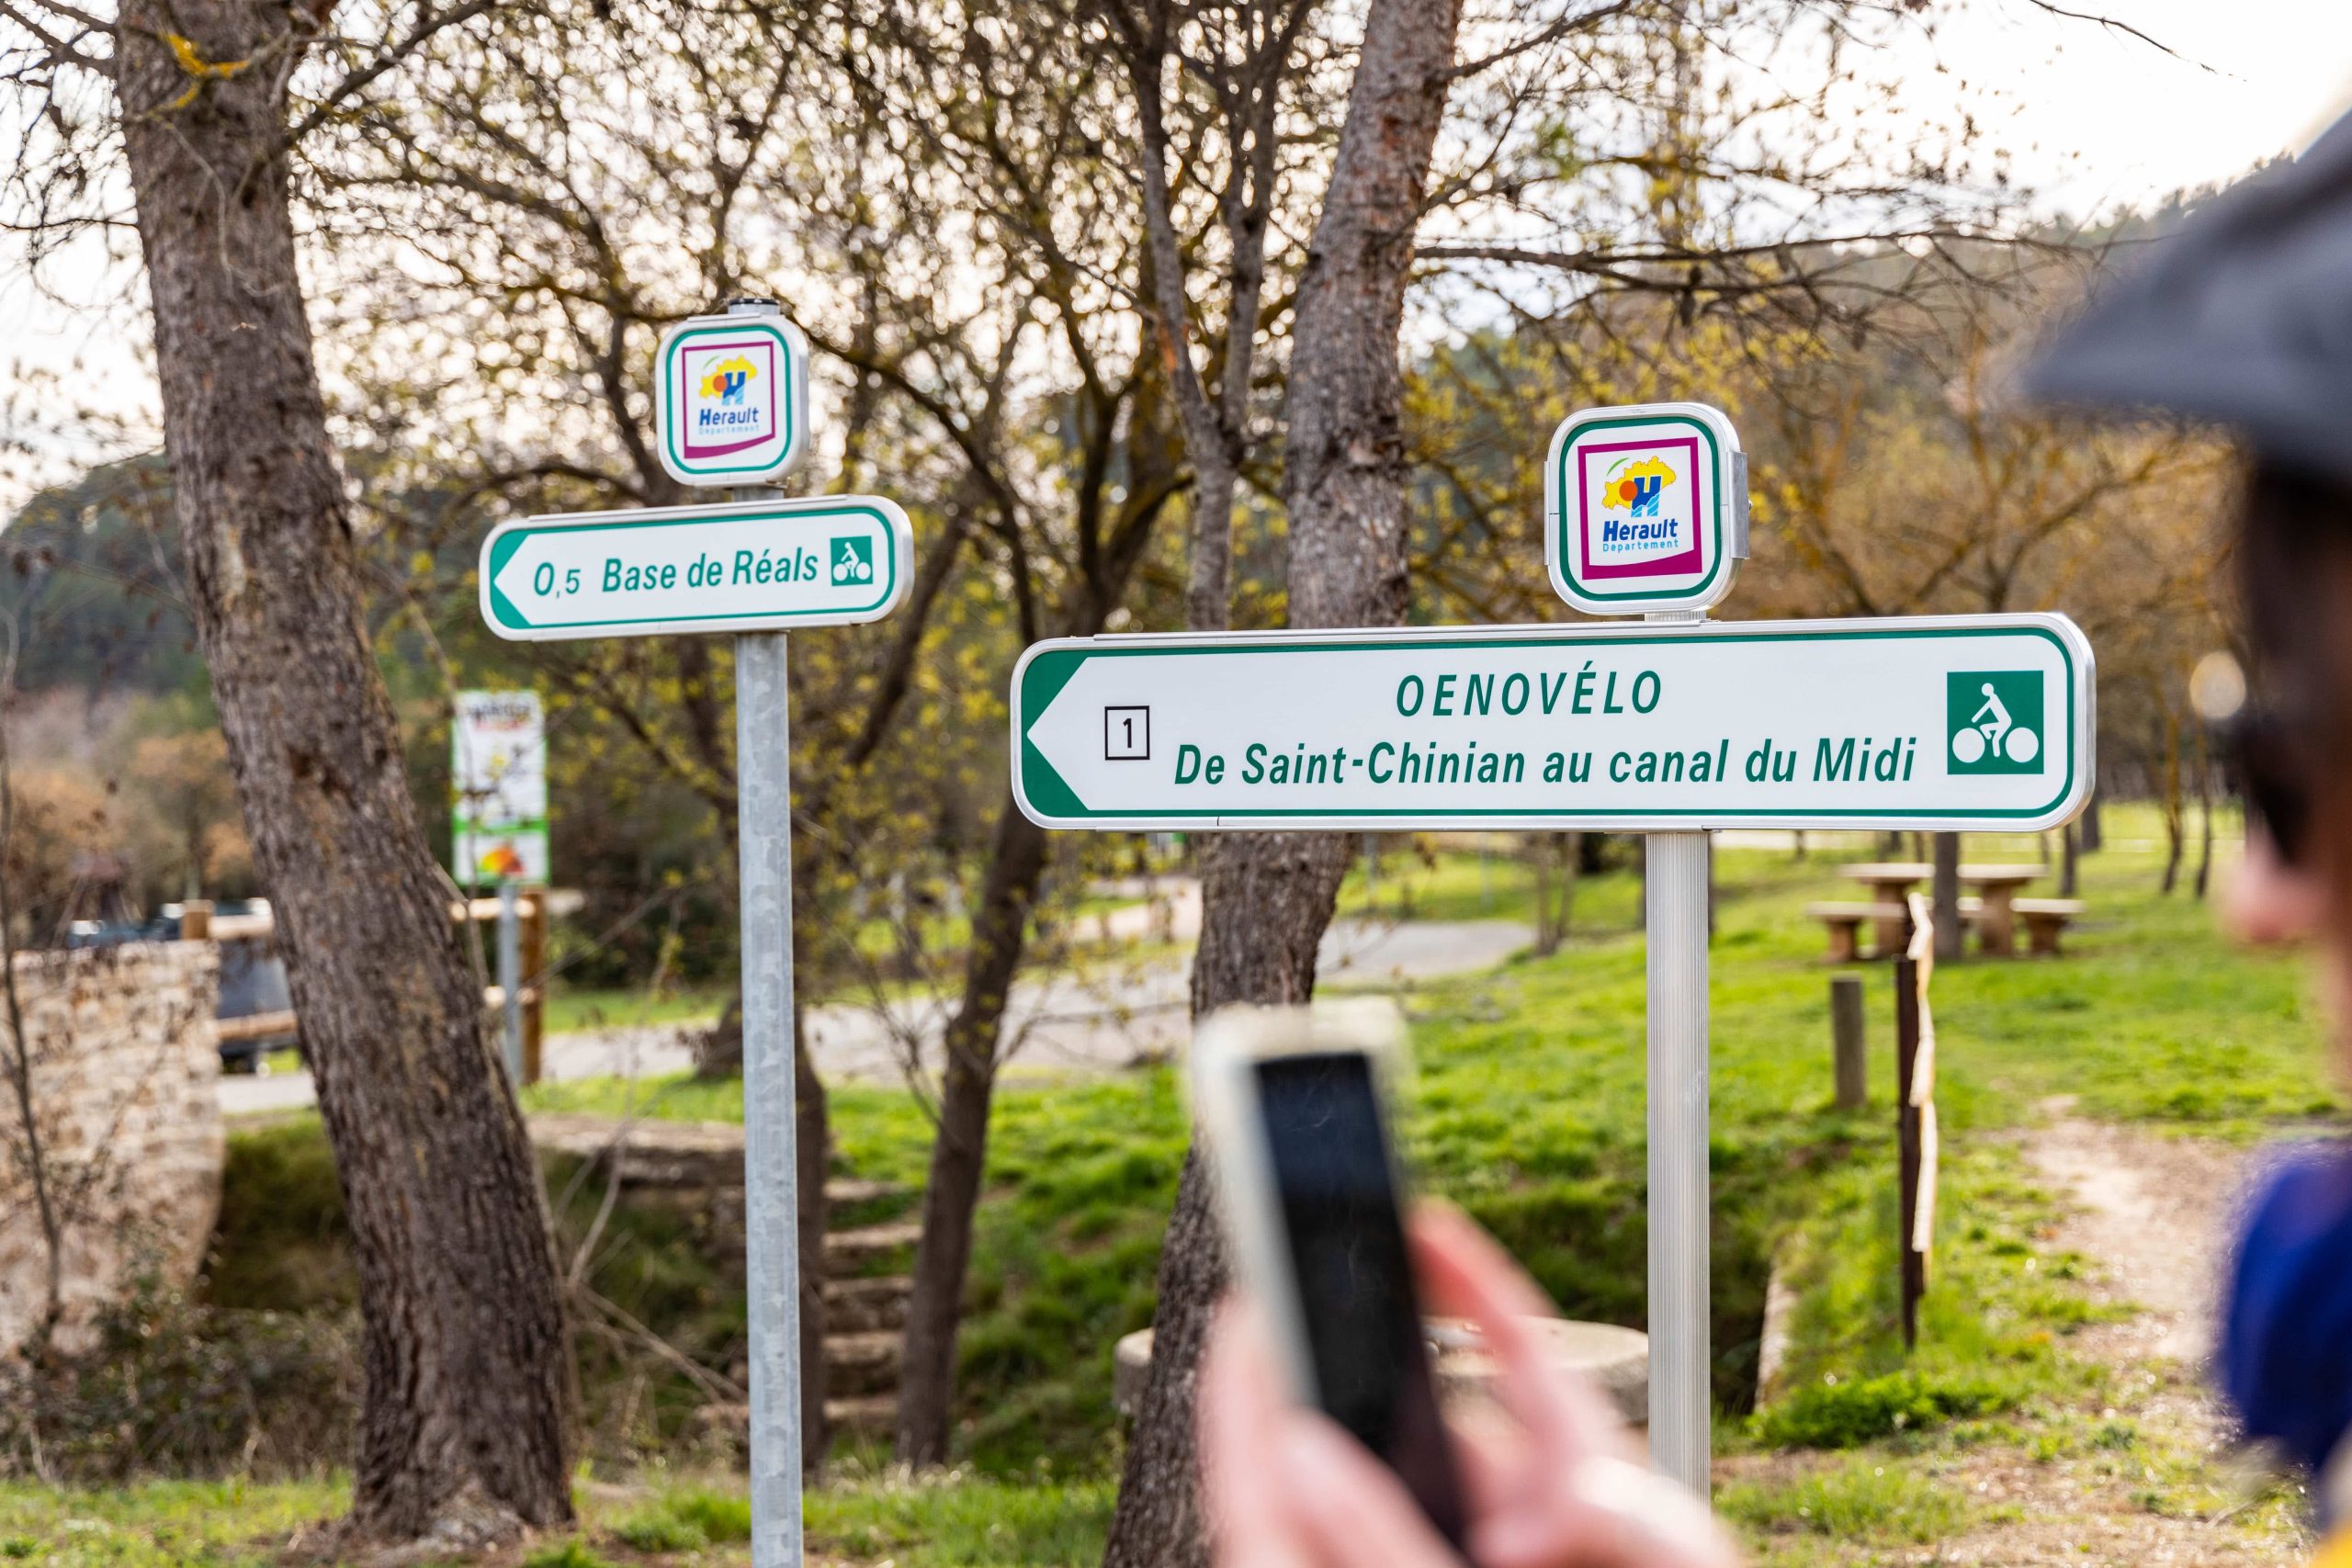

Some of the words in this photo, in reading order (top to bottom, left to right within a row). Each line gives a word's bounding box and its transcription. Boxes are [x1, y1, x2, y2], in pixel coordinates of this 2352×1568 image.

[534, 561, 581, 599] 0,5
[602, 558, 677, 592] Base
[687, 552, 723, 588] de
[731, 547, 820, 585] Réals
[1396, 660, 1662, 717] OENOVÉLO
[1123, 717, 1133, 750] 1
[1174, 743, 1226, 784] De
[1241, 740, 1525, 784] Saint-Chinian
[1543, 751, 1592, 783] au
[1609, 739, 1729, 783] canal
[1745, 739, 1797, 783] du
[1812, 737, 1917, 783] Midi
